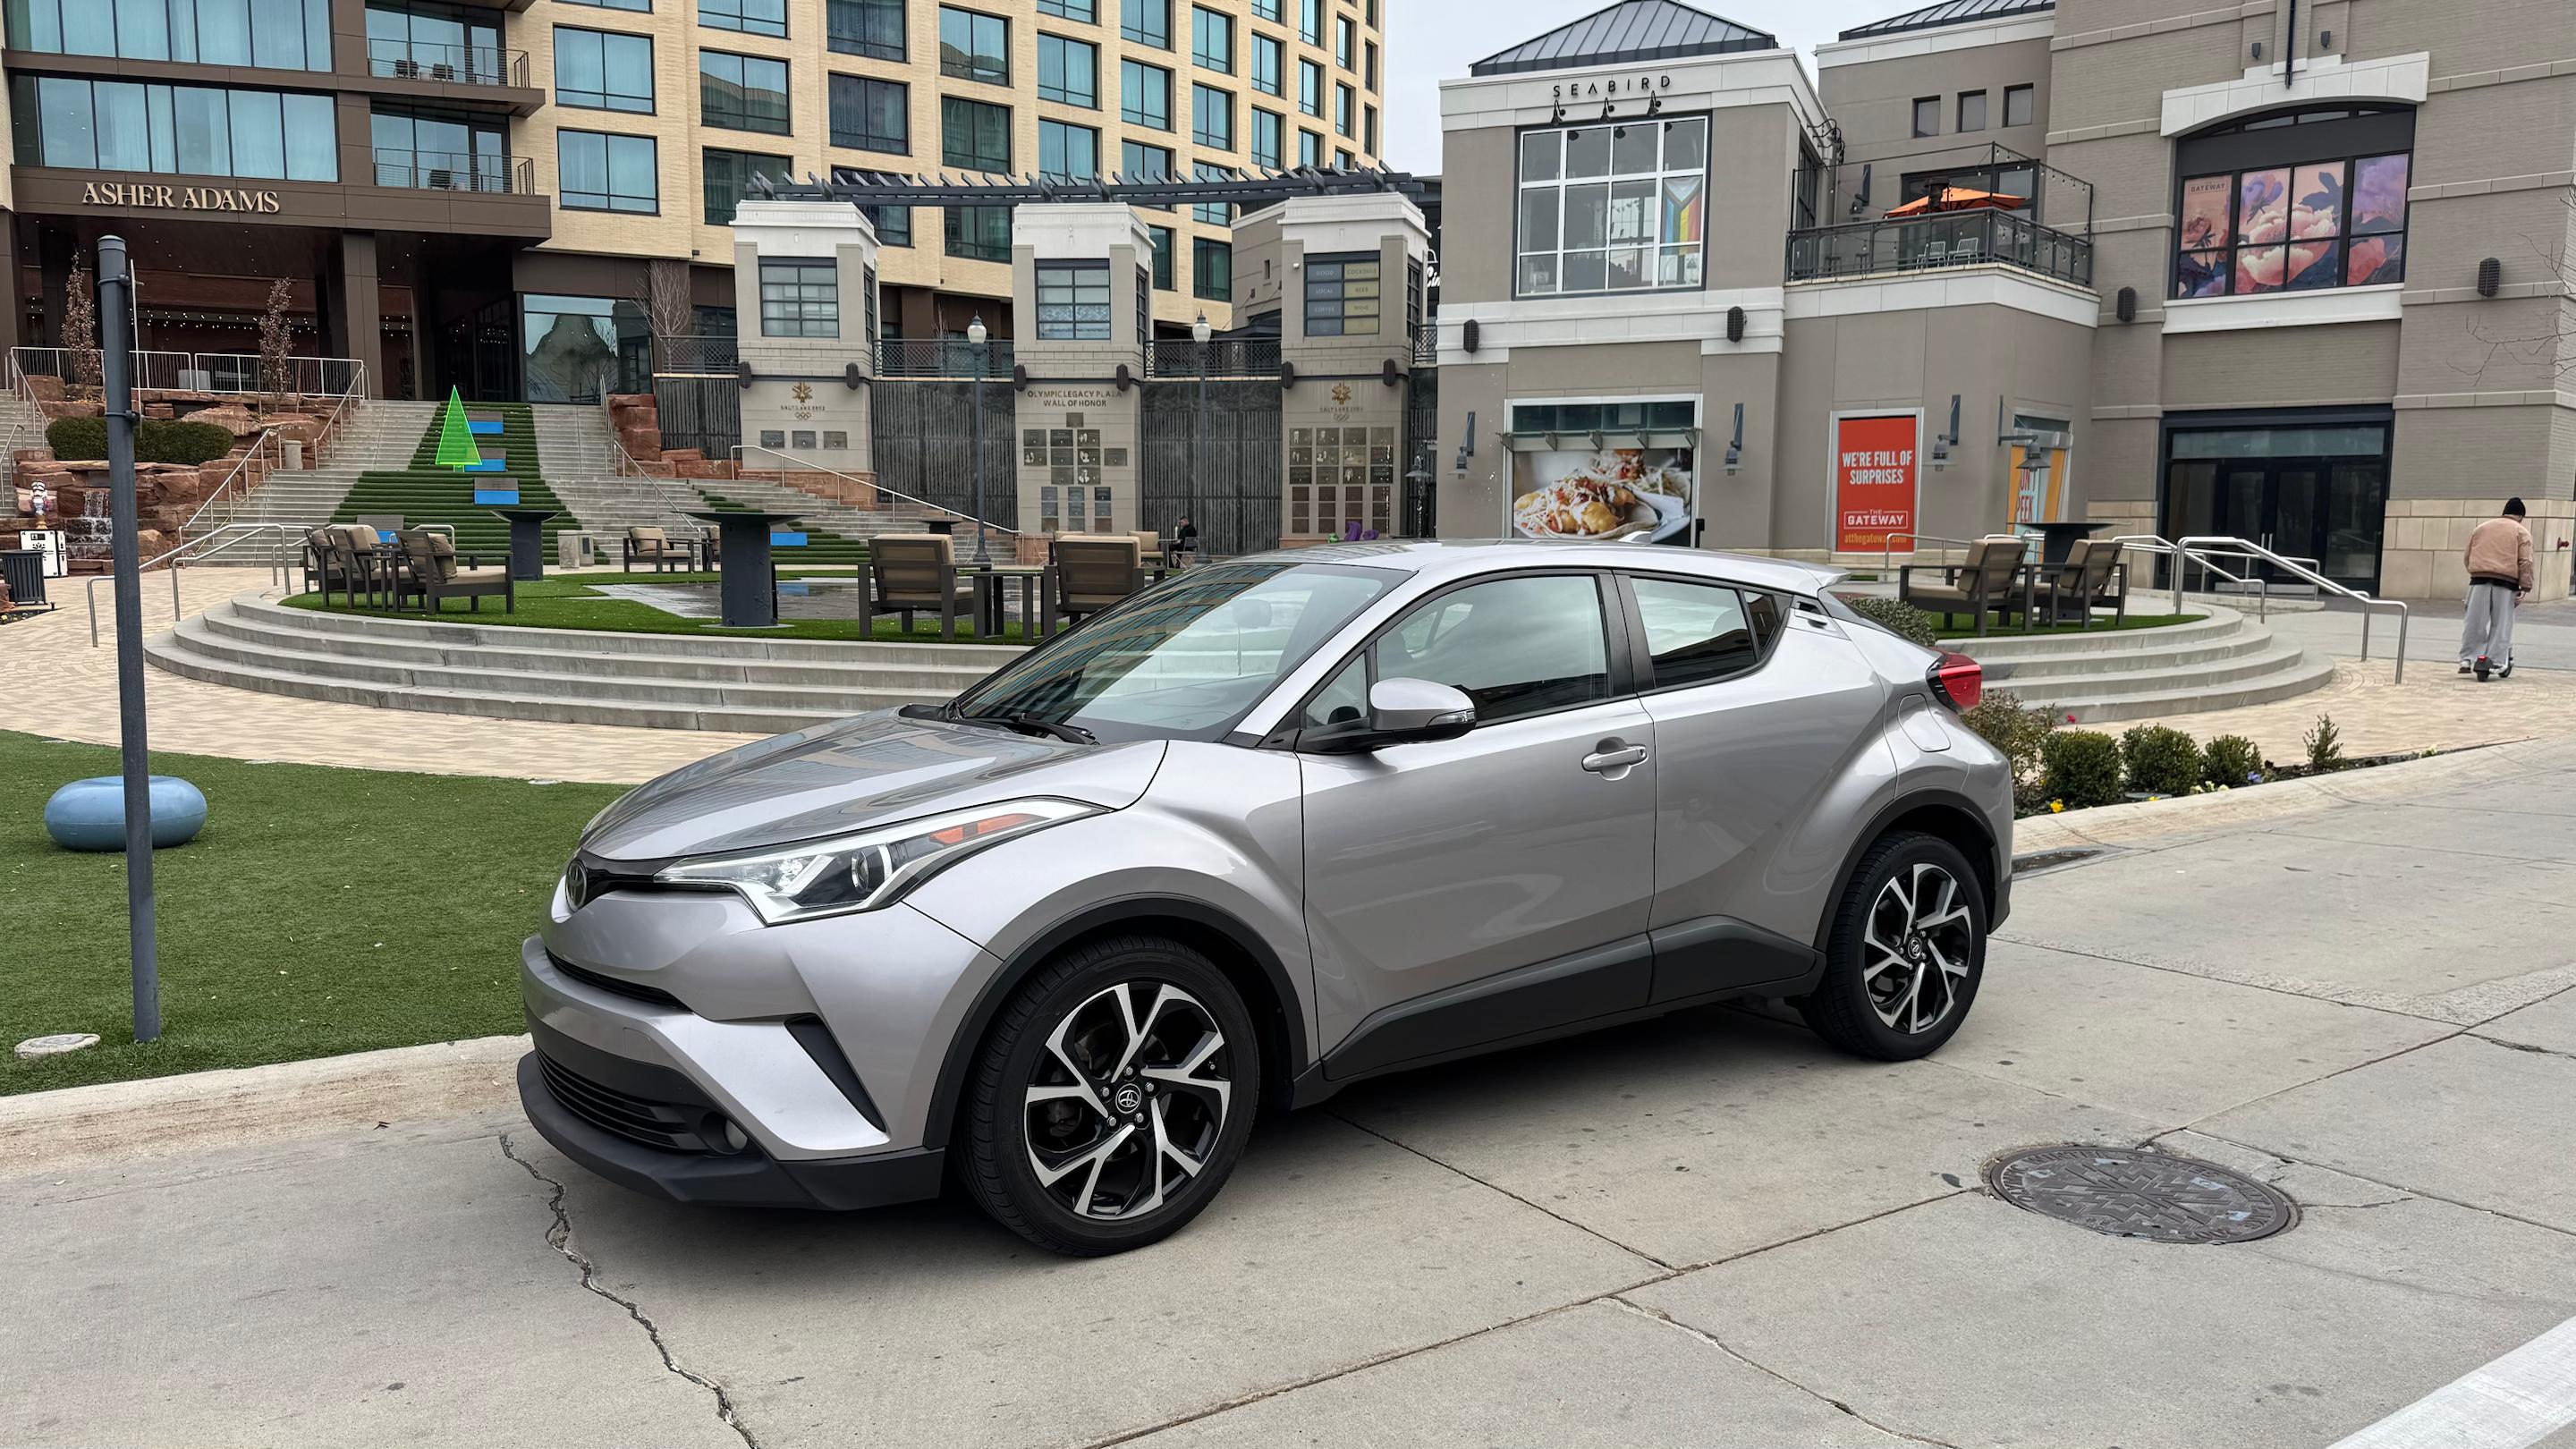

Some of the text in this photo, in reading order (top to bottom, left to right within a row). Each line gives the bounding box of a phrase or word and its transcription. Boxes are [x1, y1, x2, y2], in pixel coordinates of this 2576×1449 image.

[1553, 75, 1670, 97] SEABIRD
[2190, 183, 2225, 192] GATEWAY
[82, 182, 280, 214] ASHER ADAMS
[1028, 390, 1063, 398] OLYMPIC
[1063, 390, 1095, 398] LEGACY
[1843, 450, 1912, 467] WE'RE FULL OF
[1850, 469, 1903, 485] SURPRISES
[1847, 515, 1904, 525] GATEWAY
[1845, 532, 1907, 546] atthegatewa.com
